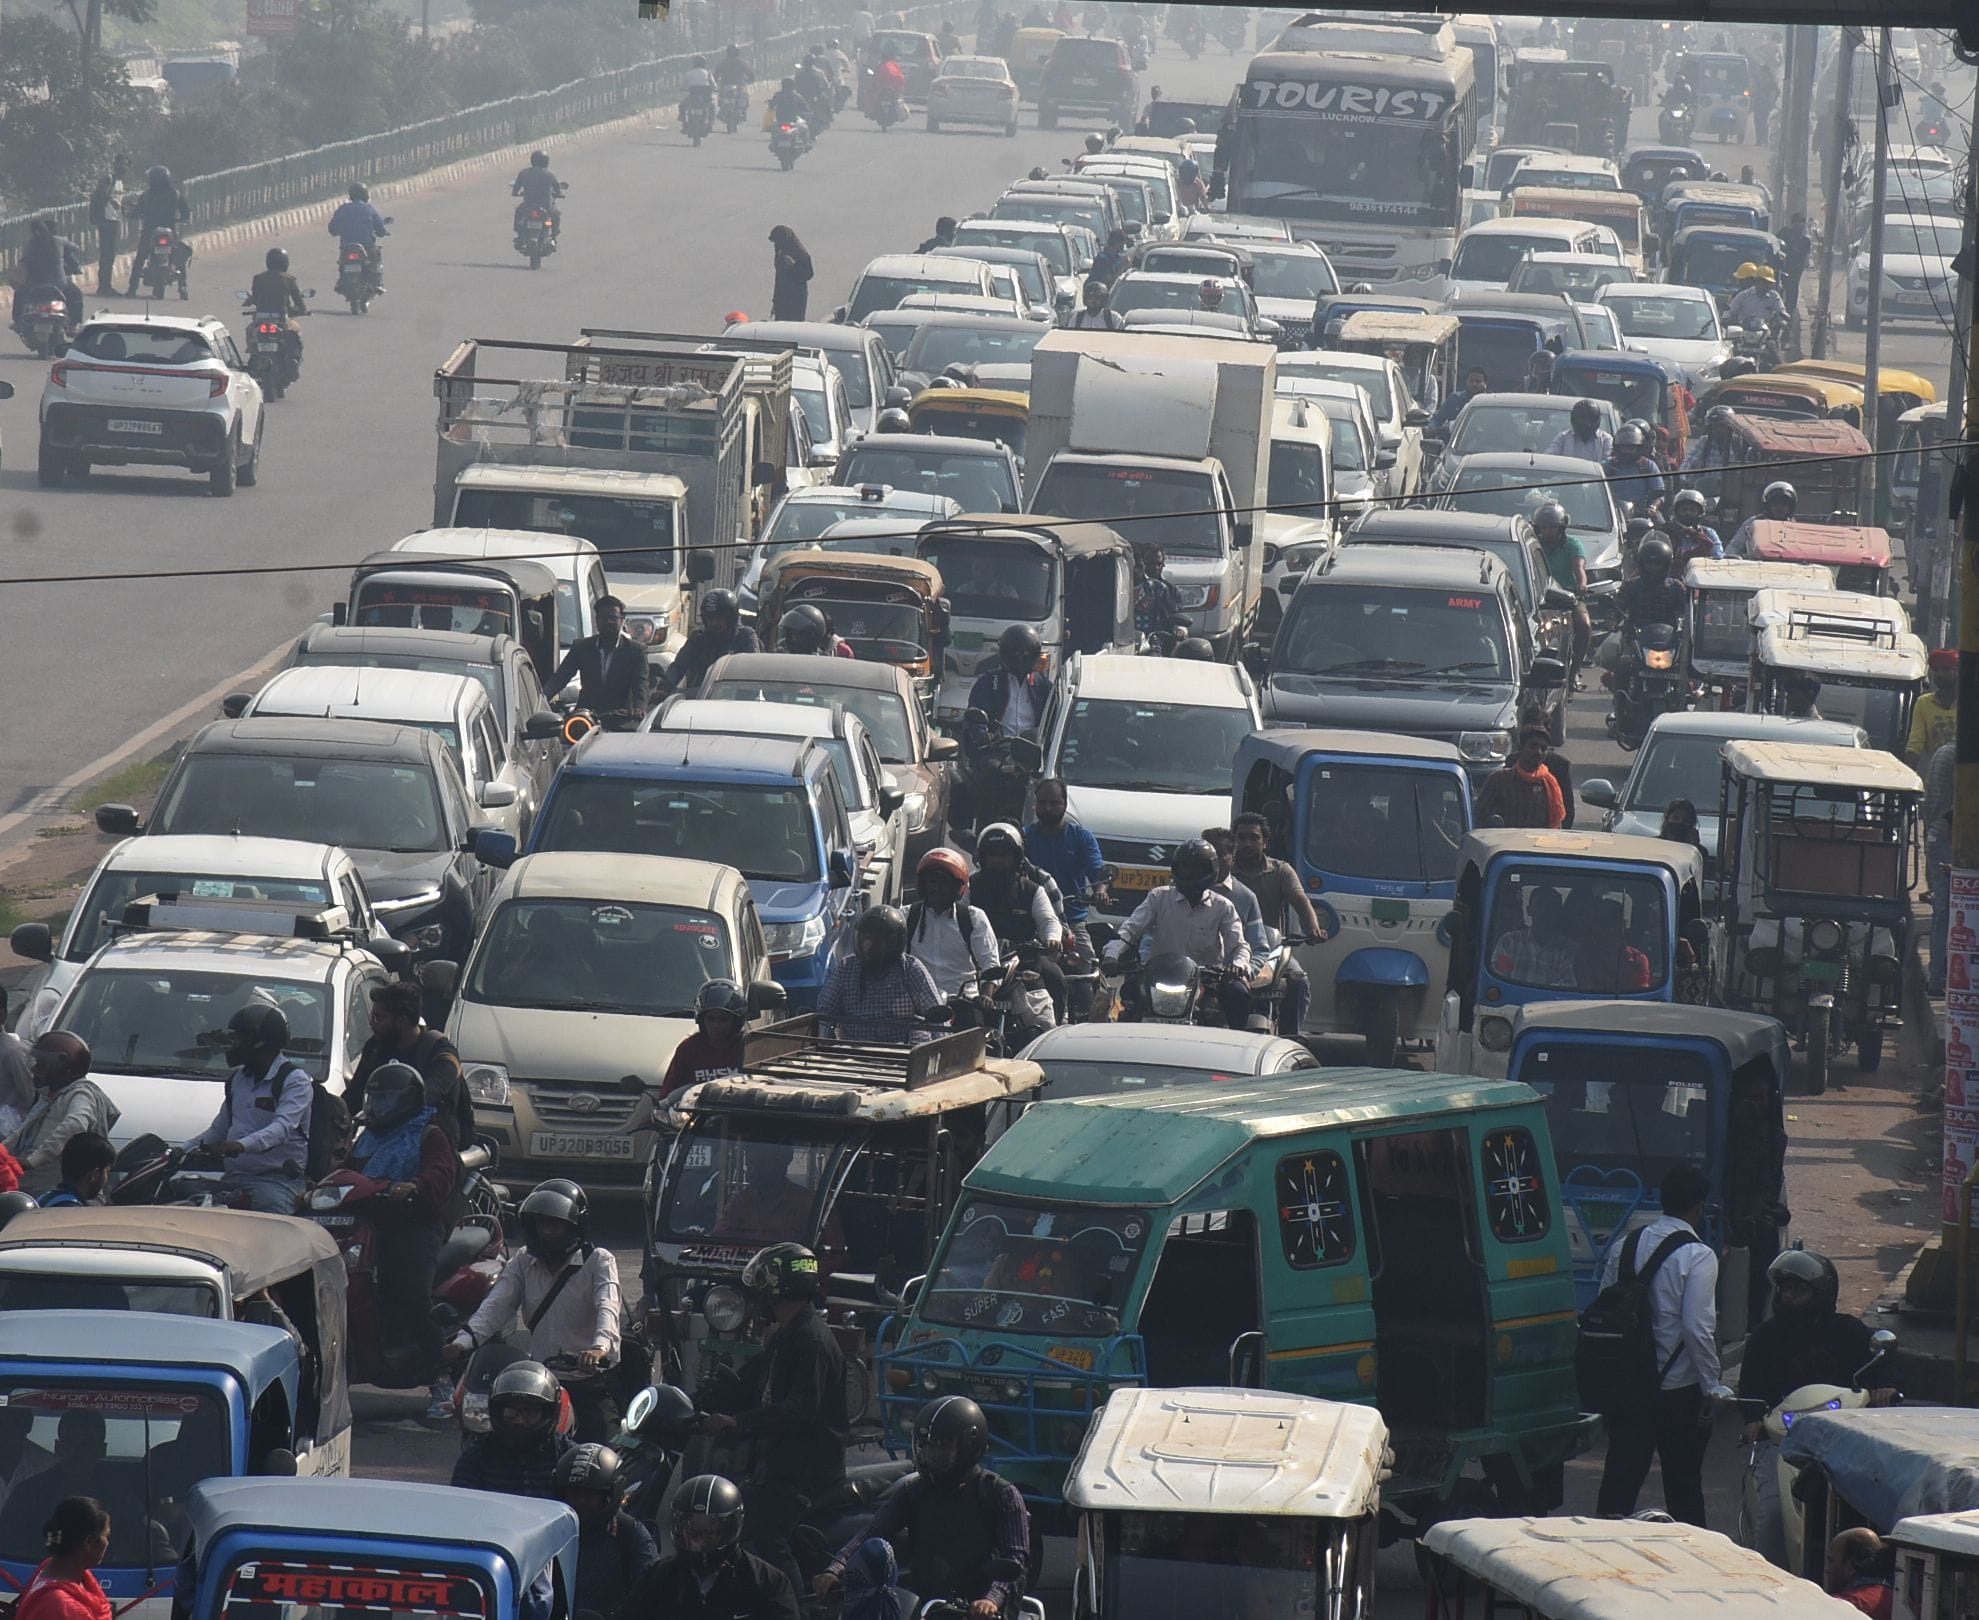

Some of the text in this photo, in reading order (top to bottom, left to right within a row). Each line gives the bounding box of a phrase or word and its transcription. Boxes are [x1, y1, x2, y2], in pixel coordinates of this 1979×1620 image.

[1253, 80, 1445, 119] TOURIST
[1321, 112, 1377, 124] LUCKNOW
[1448, 598, 1482, 609] ARMY
[672, 923, 718, 935] ADVOCATE
[1668, 1080, 1704, 1089] POLICE
[964, 1293, 998, 1321] SUPER
[1041, 1301, 1071, 1324] FAST
[94, 1393, 178, 1404] Automobiles
[260, 1573, 454, 1606] महाकाल
